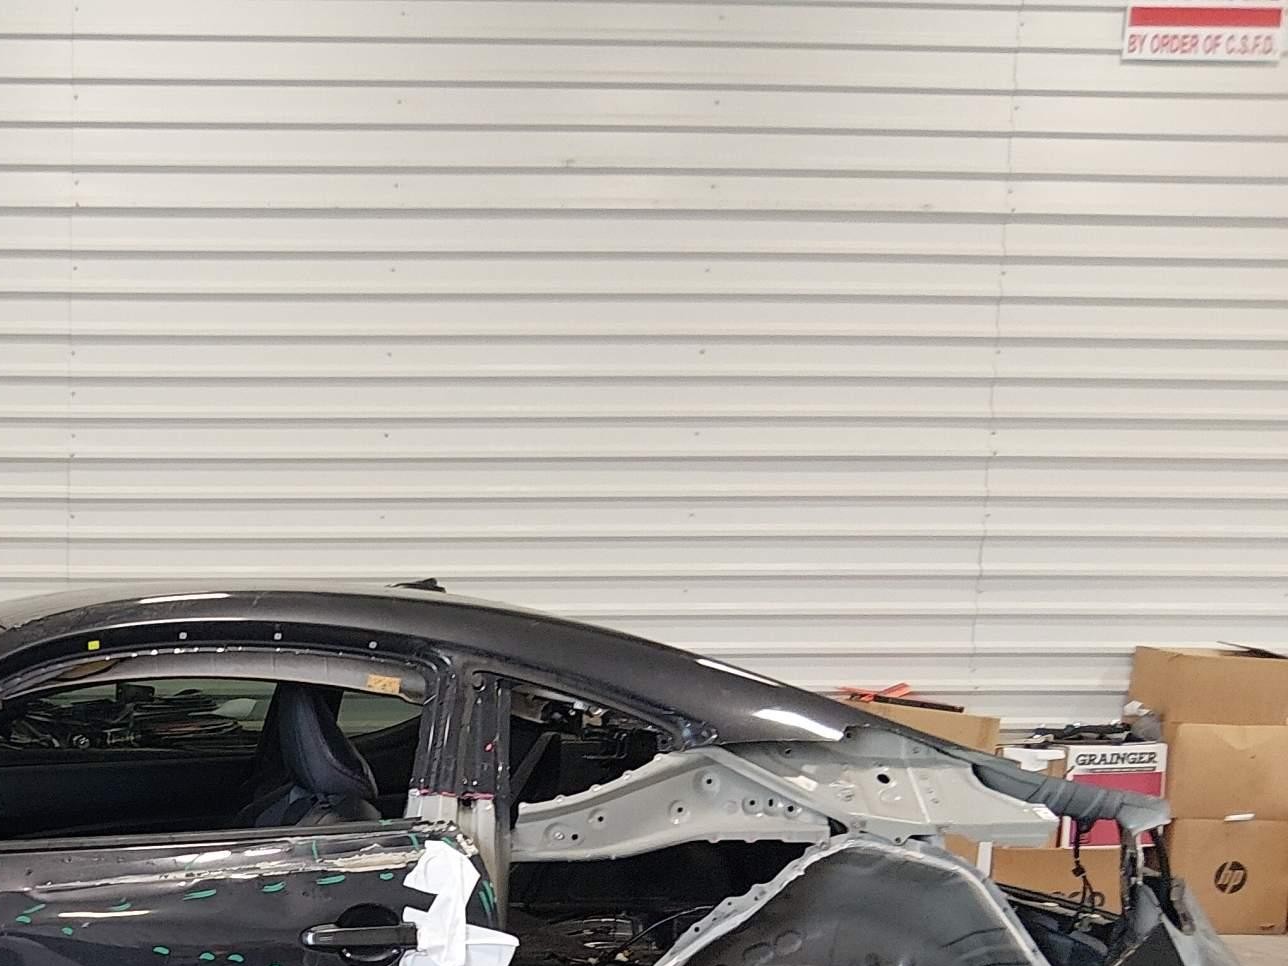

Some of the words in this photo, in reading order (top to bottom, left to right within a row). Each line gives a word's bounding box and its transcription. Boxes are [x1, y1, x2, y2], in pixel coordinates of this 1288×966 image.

[1128, 34, 1146, 54] BY
[1150, 34, 1199, 54] ORDER
[1203, 34, 1223, 54] OF
[1076, 752, 1157, 766] GRAINGER
[1214, 860, 1247, 894] hp
